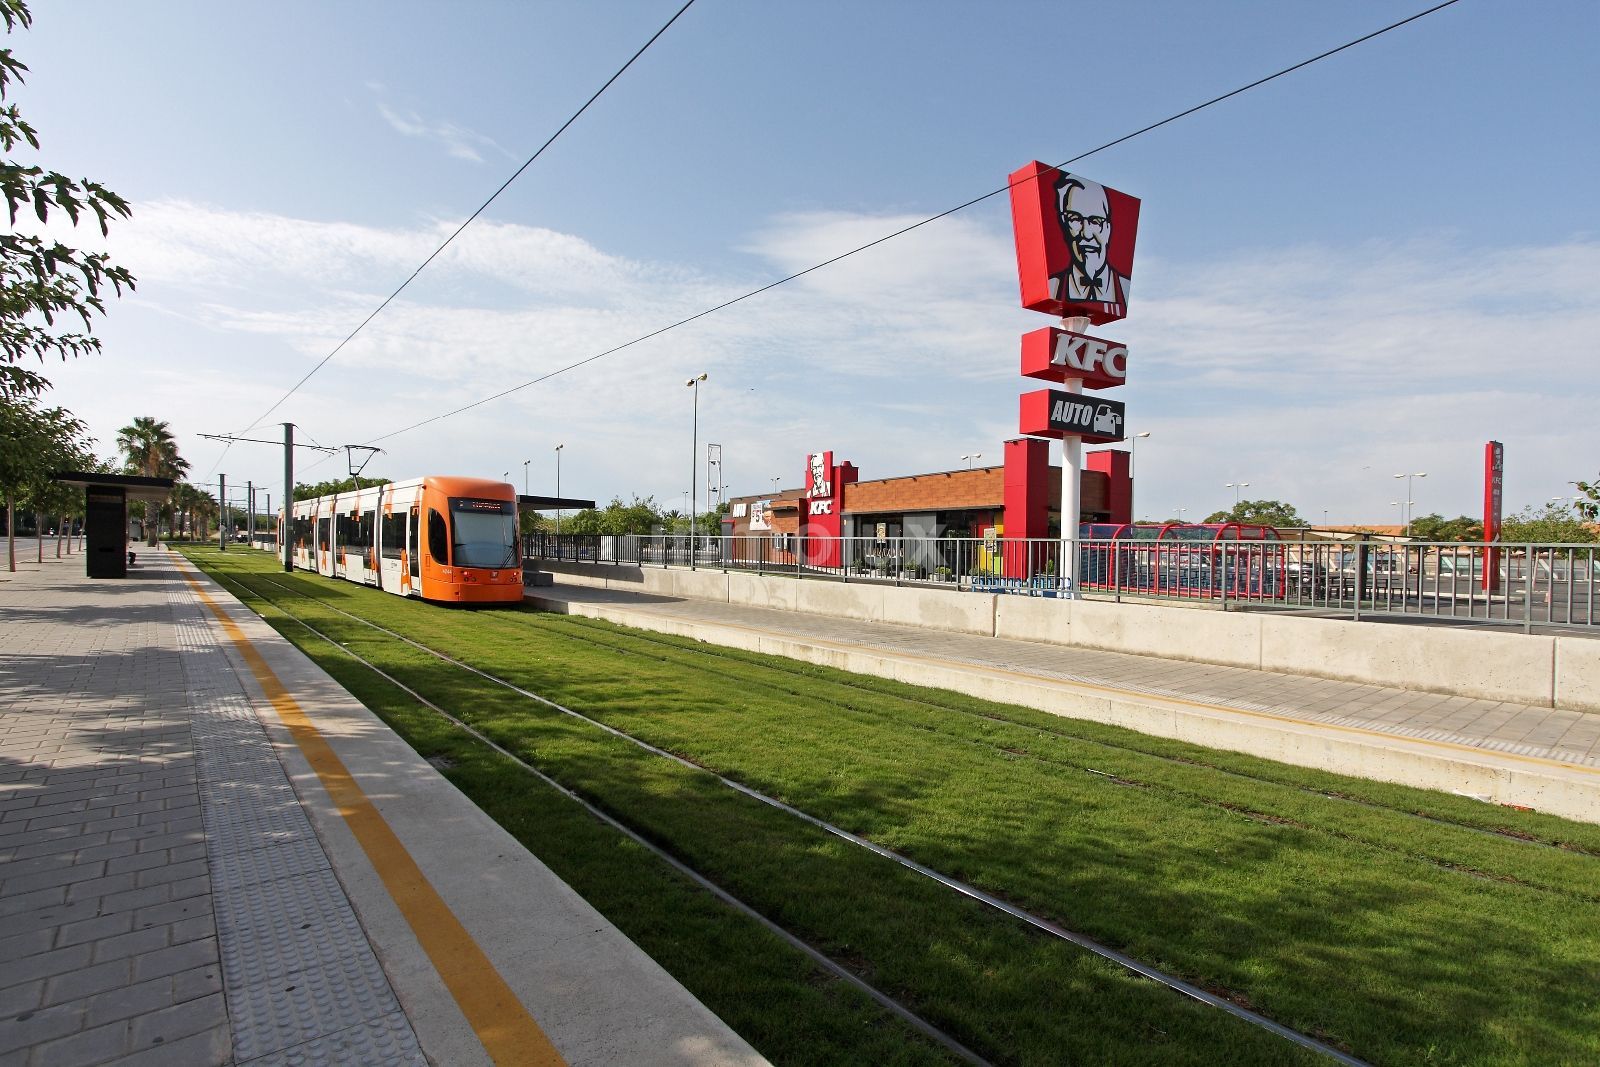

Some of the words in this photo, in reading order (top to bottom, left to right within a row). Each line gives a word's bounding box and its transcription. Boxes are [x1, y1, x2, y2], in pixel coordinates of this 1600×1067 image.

[1051, 333, 1128, 378] KFC
[1051, 400, 1093, 426] AUTO
[809, 500, 833, 515] KFC
